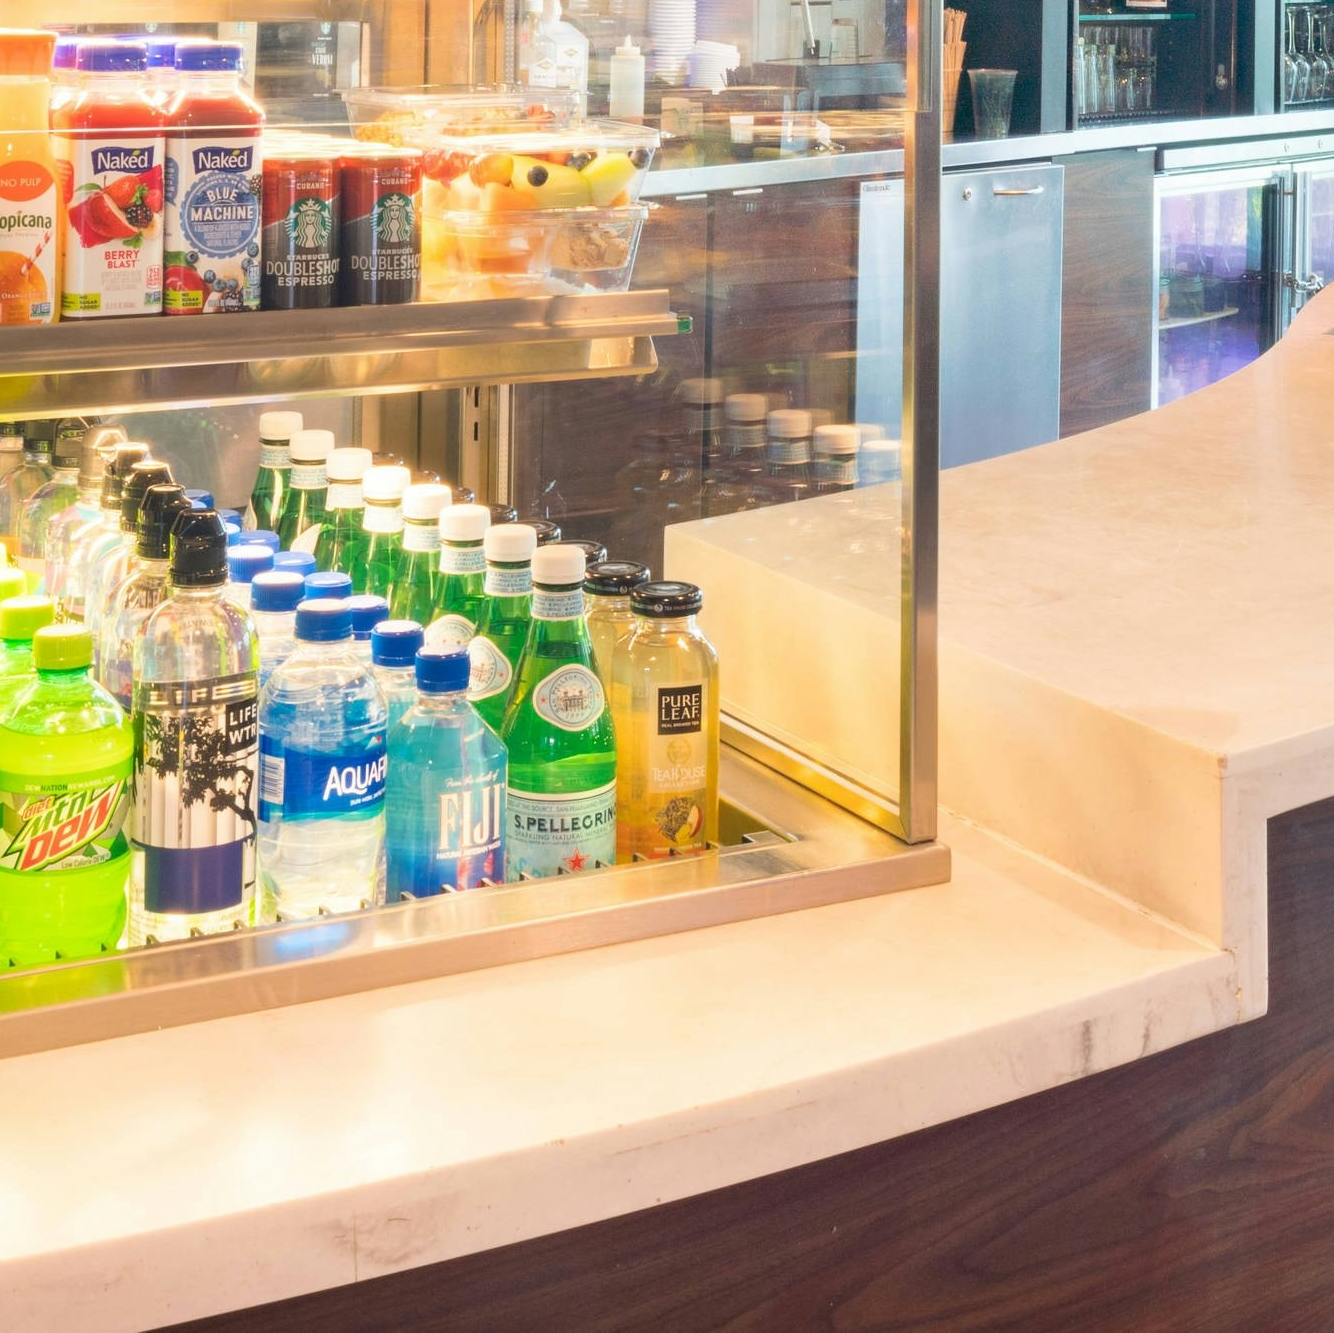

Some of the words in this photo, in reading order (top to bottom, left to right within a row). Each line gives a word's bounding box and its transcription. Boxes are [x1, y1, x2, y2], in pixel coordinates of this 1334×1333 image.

[98, 152, 148, 169] Naked
[199, 152, 248, 169] Naked
[1, 178, 17, 187] NO
[20, 178, 41, 186] PULP
[207, 188, 239, 202] BLUE
[191, 206, 253, 221] MACHINE
[105, 250, 139, 260] BERRY
[352, 253, 421, 270] DOUBLESHO
[107, 260, 137, 269] BLAST
[267, 258, 341, 276] DOUBLESHOT
[278, 275, 334, 287] ESPRESSO
[661, 694, 699, 708] PURE
[230, 705, 257, 725] LIFE
[661, 708, 699, 721] LEAF
[230, 729, 257, 745] WTR
[323, 756, 387, 800] AQUAF
[439, 783, 505, 850] FIJI
[515, 805, 616, 833] S.PELLEGRIN
